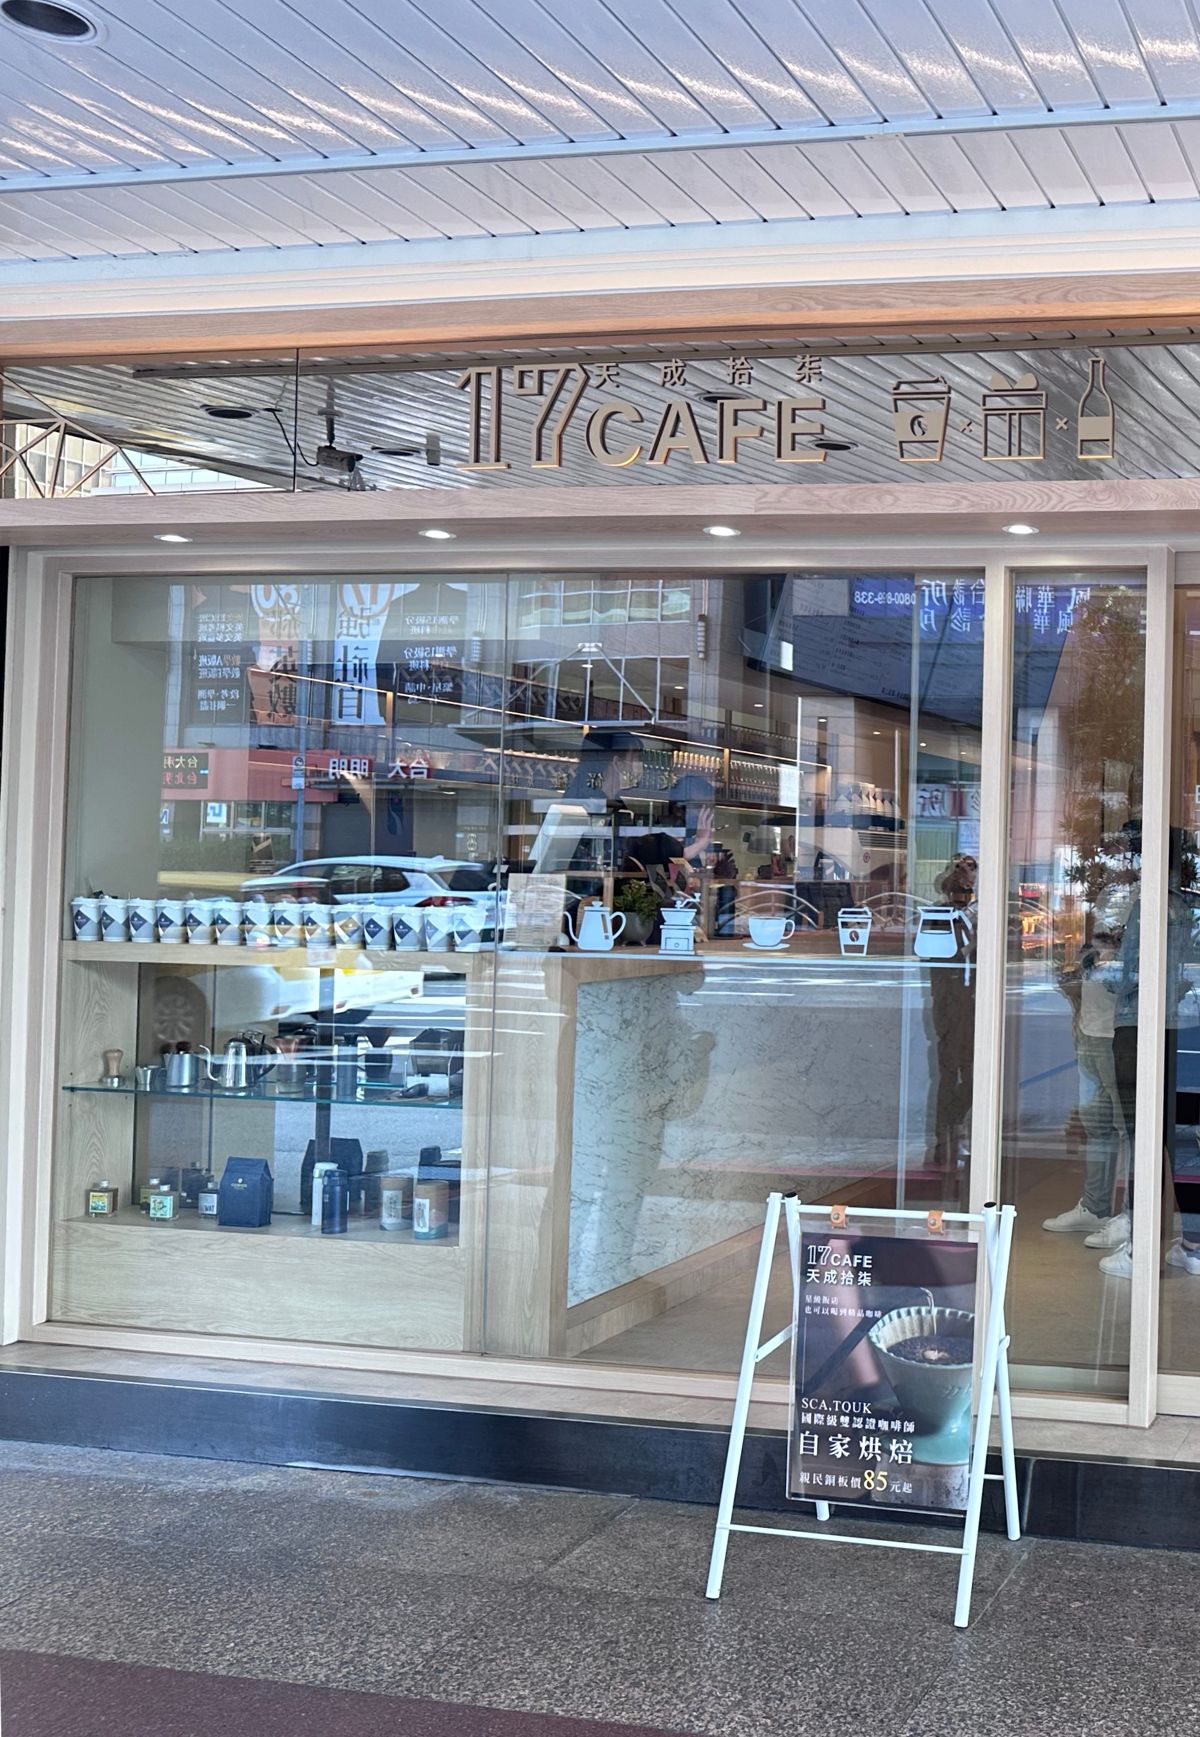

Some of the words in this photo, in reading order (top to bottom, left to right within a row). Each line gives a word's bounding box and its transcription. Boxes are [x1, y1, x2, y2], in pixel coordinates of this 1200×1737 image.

[593, 354, 823, 388] 天成拾柒
[806, 1268, 872, 1287] 天成拾柒
[799, 1430, 913, 1465] 自家烘焙
